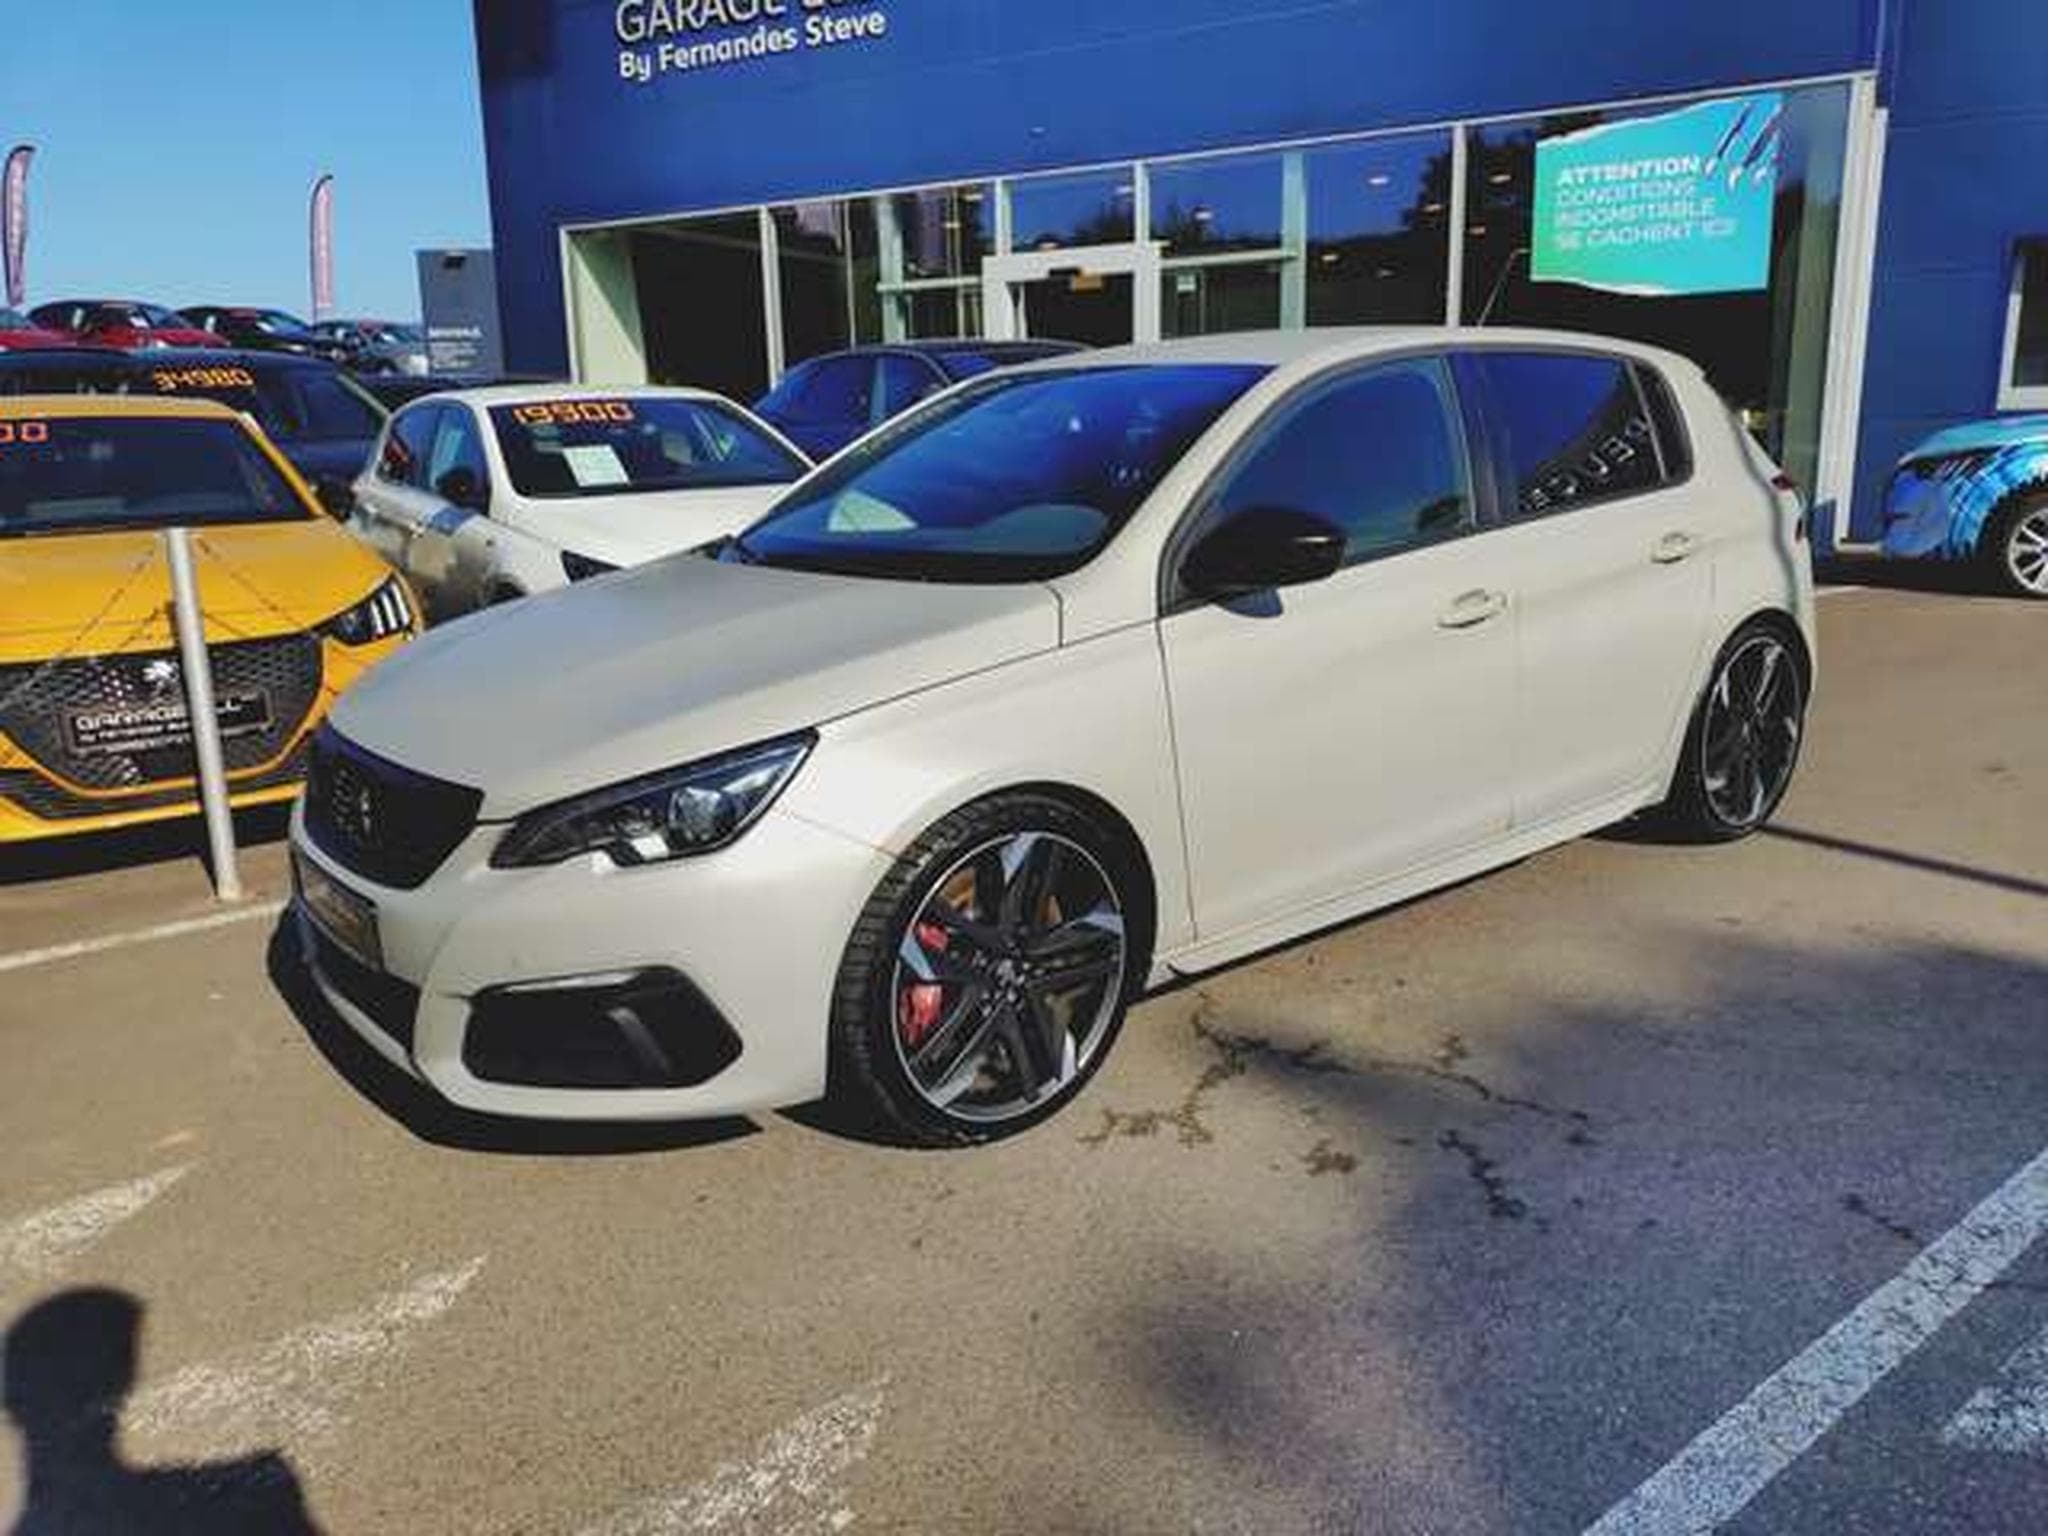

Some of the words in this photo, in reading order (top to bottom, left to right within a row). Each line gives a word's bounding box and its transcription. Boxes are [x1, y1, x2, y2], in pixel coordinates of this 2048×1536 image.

[619, 51, 651, 81] By
[659, 25, 799, 71] Fernandes
[805, 11, 886, 46] Steve
[1558, 156, 1699, 186] ATTENTION
